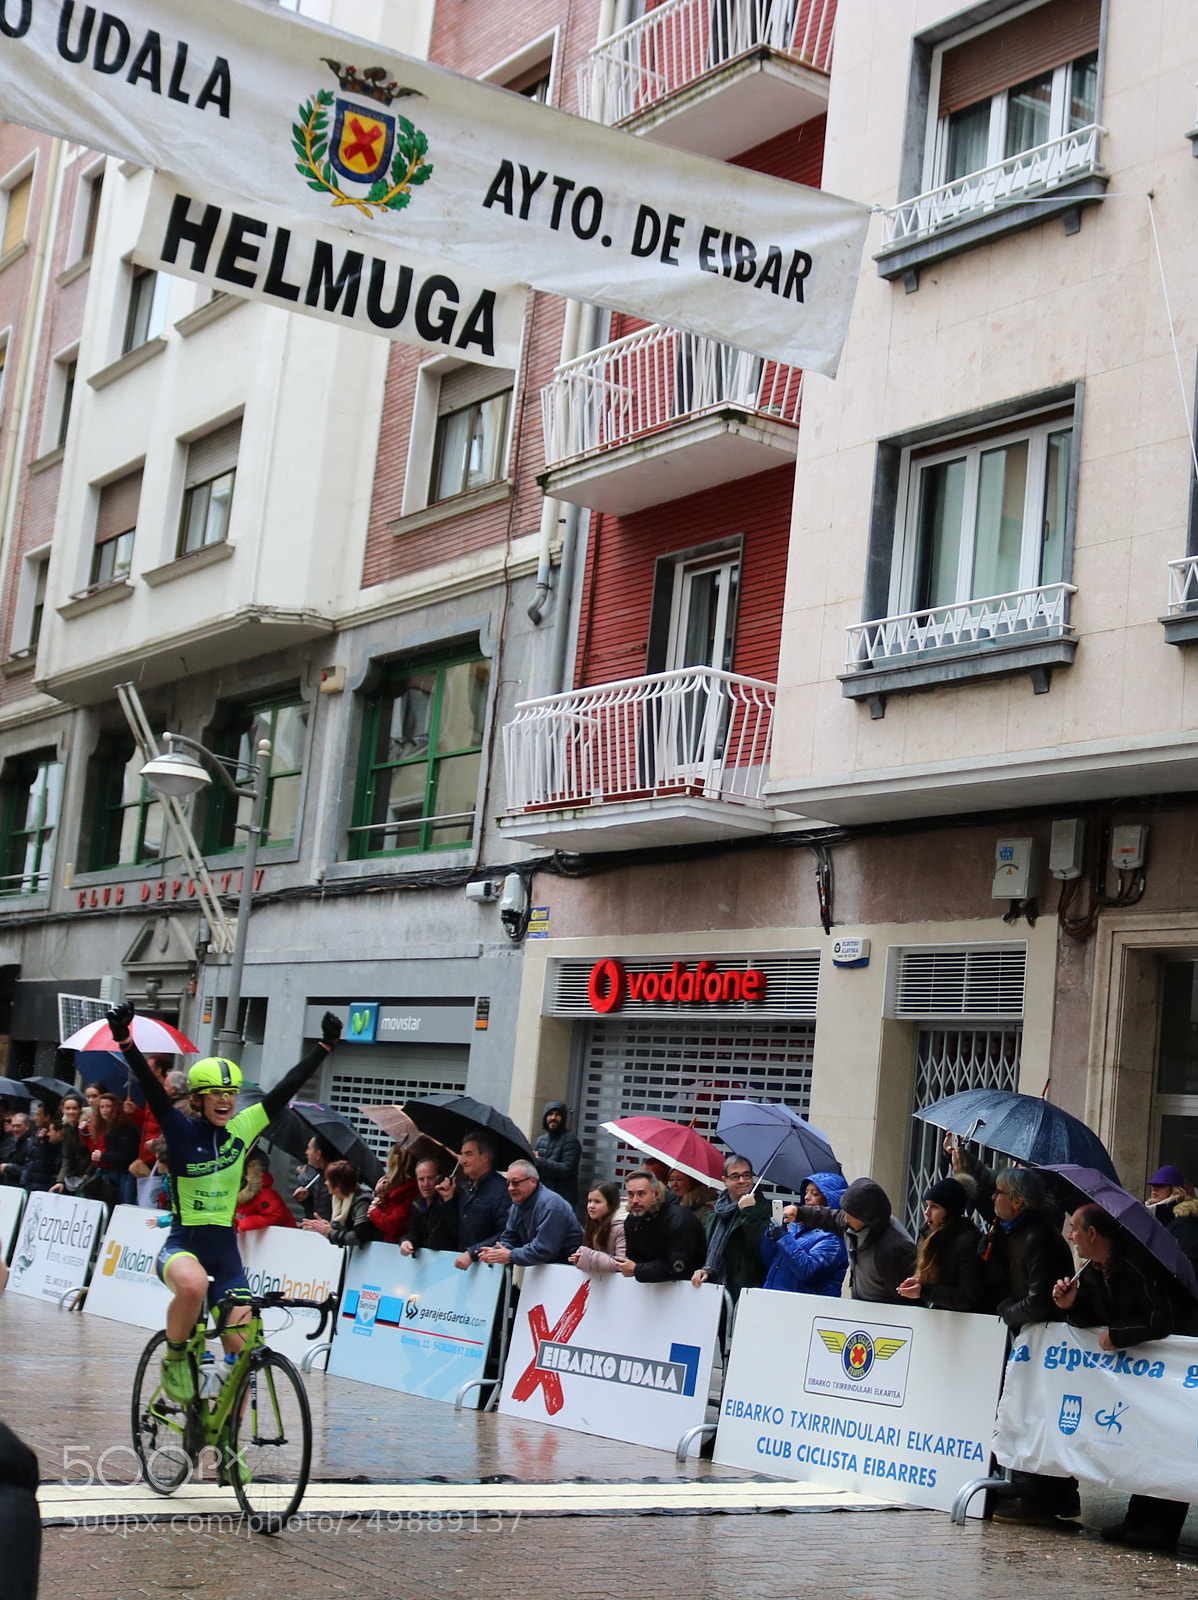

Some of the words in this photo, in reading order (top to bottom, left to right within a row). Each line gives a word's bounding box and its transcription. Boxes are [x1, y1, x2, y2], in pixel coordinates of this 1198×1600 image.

[57, 0, 231, 119] UDALA
[482, 158, 613, 247] AYTO.
[631, 204, 685, 266] DE
[699, 225, 813, 304] EIBAR
[160, 193, 497, 357] HELMUGA
[77, 886, 124, 908] CLUB
[627, 961, 767, 1001] vodafone
[381, 1016, 421, 1031] movistar
[38, 1204, 93, 1260] ezpeleta
[542, 1346, 616, 1379] EIBARKO
[619, 1359, 678, 1391] UDALA
[1044, 1341, 1165, 1379] gipuzkoa
[808, 1378, 831, 1388] EIBARKO
[833, 1381, 873, 1394] TXIRRINDULARI
[874, 1388, 901, 1399] ELKARTEA
[725, 1399, 785, 1425] EIBARKO
[791, 1410, 901, 1447] TXIRRINDULARI
[907, 1430, 984, 1462] ELKARTEA
[756, 1436, 792, 1458] CLUB
[797, 1444, 858, 1472] CICLISTA
[863, 1456, 937, 1488] EIBARRES
